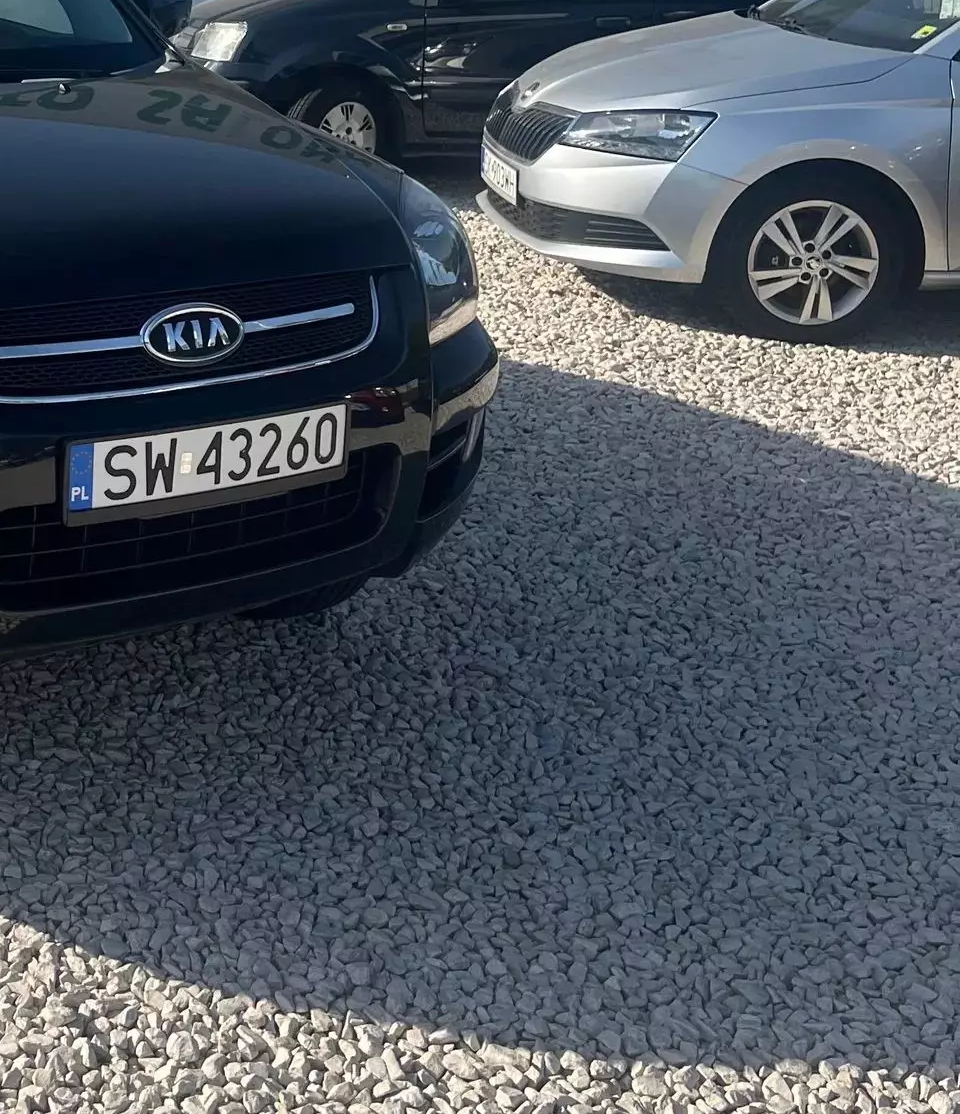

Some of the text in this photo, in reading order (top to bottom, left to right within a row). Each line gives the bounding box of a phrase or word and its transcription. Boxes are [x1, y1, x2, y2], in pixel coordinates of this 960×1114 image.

[162, 317, 231, 353] KIA
[104, 412, 338, 501] SW 43260
[71, 486, 89, 502] PL
